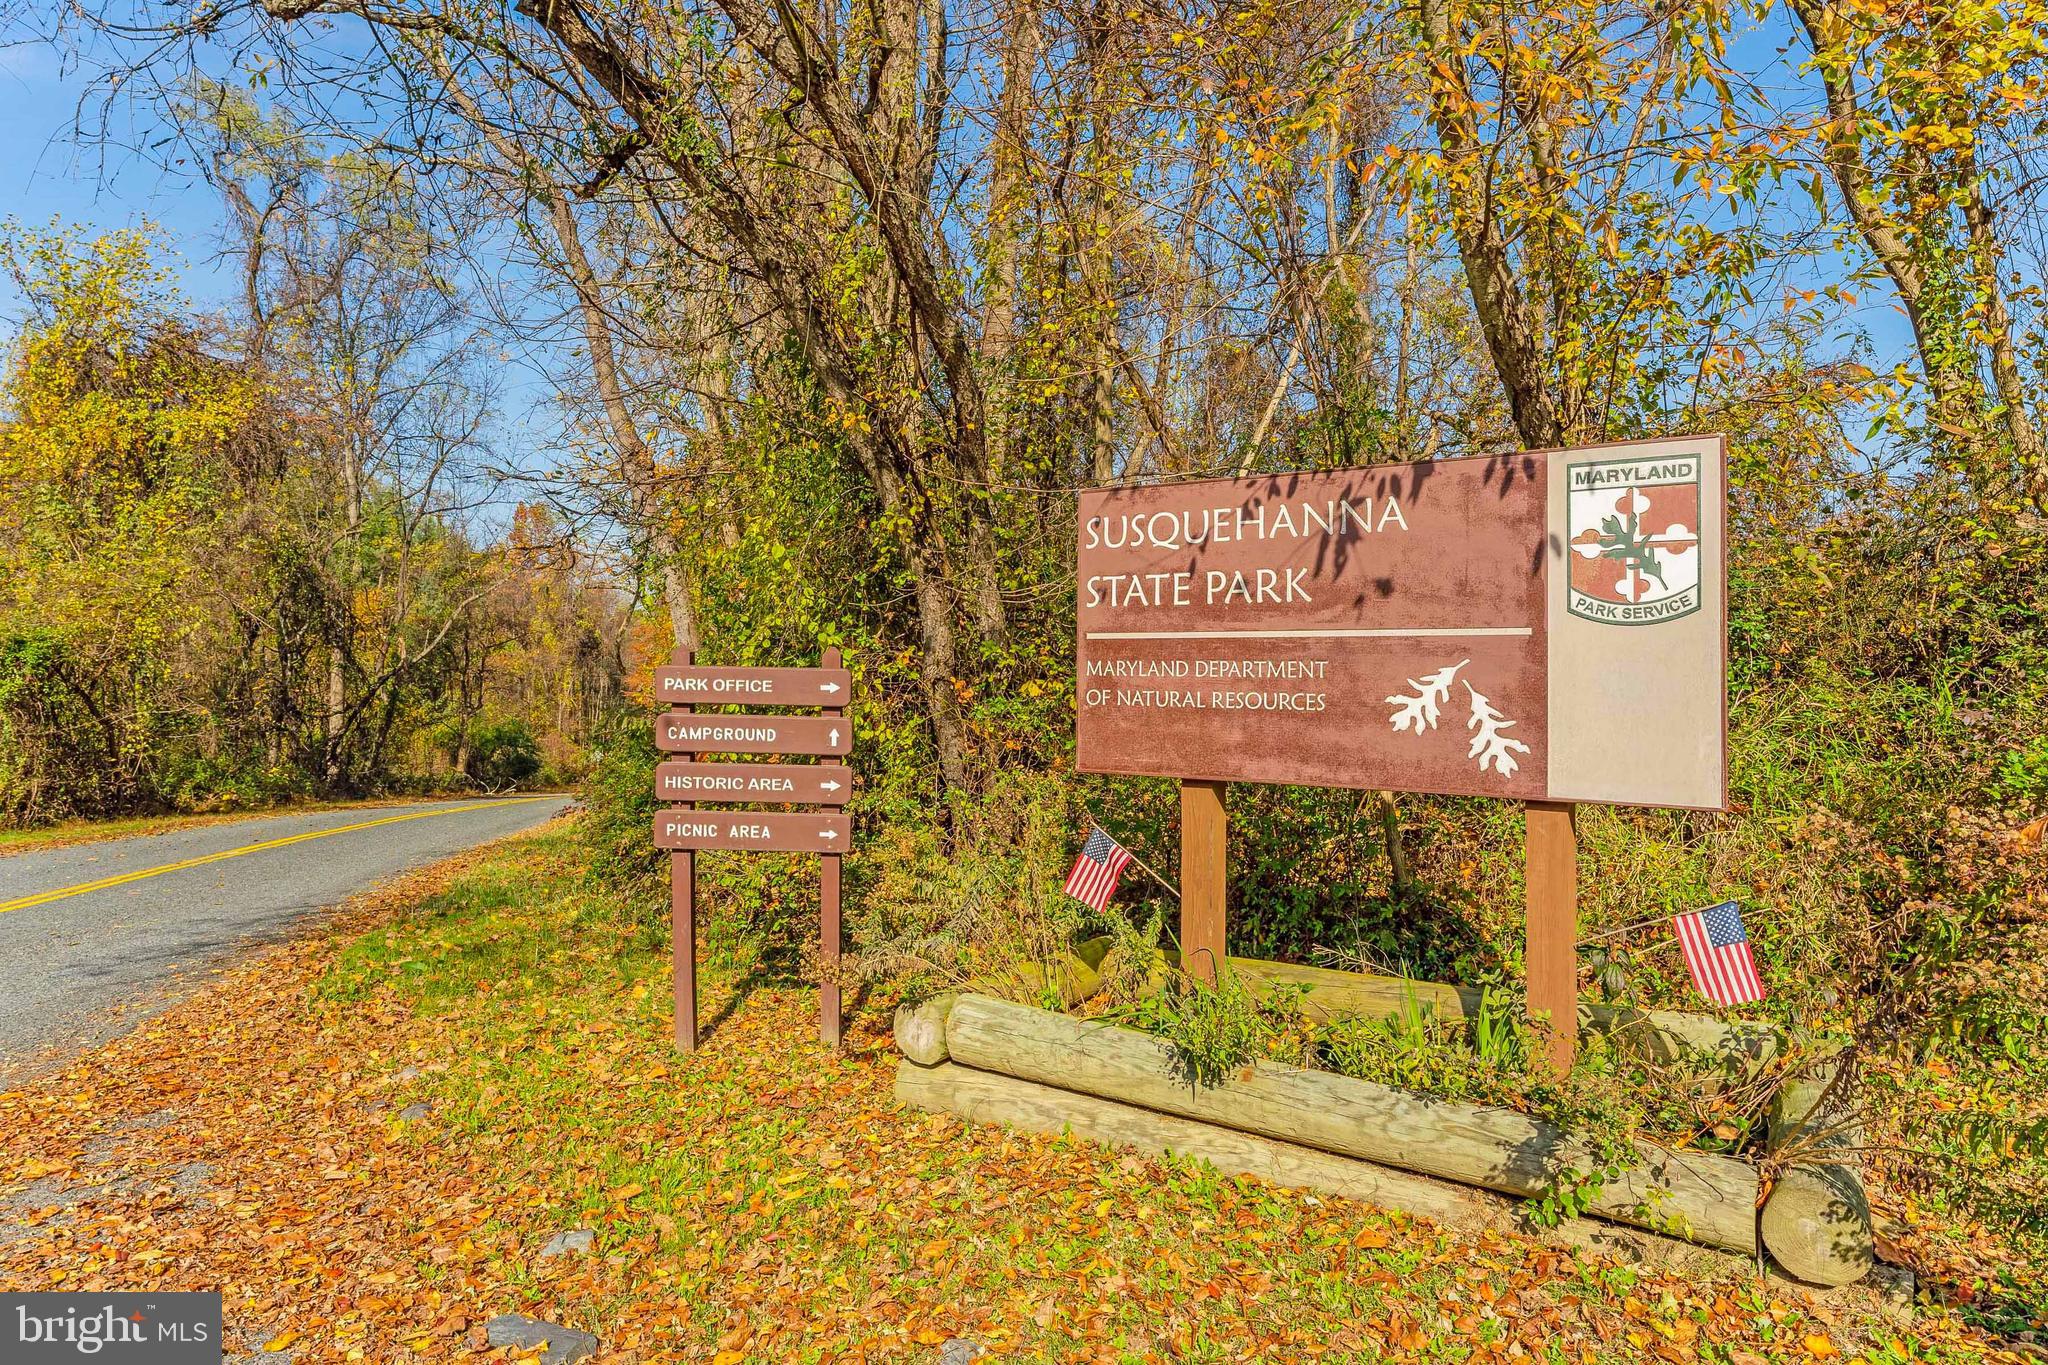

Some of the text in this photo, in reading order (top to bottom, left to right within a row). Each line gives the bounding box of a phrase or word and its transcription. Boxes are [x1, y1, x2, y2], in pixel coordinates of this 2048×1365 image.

[1575, 463, 1692, 485] MARYLAND
[1085, 495, 1408, 551] SUSQUEHANNA
[1086, 567, 1313, 608] STATE PARK
[1575, 594, 1693, 619] PARK SERVICE
[1086, 659, 1329, 680] MARYLAND DEPARTMENT
[664, 677, 773, 693] PARK OFFICE
[1086, 689, 1326, 712] OF NATURAL RESOURCES
[668, 726, 777, 742] CAMPGROUND
[664, 776, 794, 791] HISTORIC AREA
[666, 823, 771, 839] PICNIC AREA
